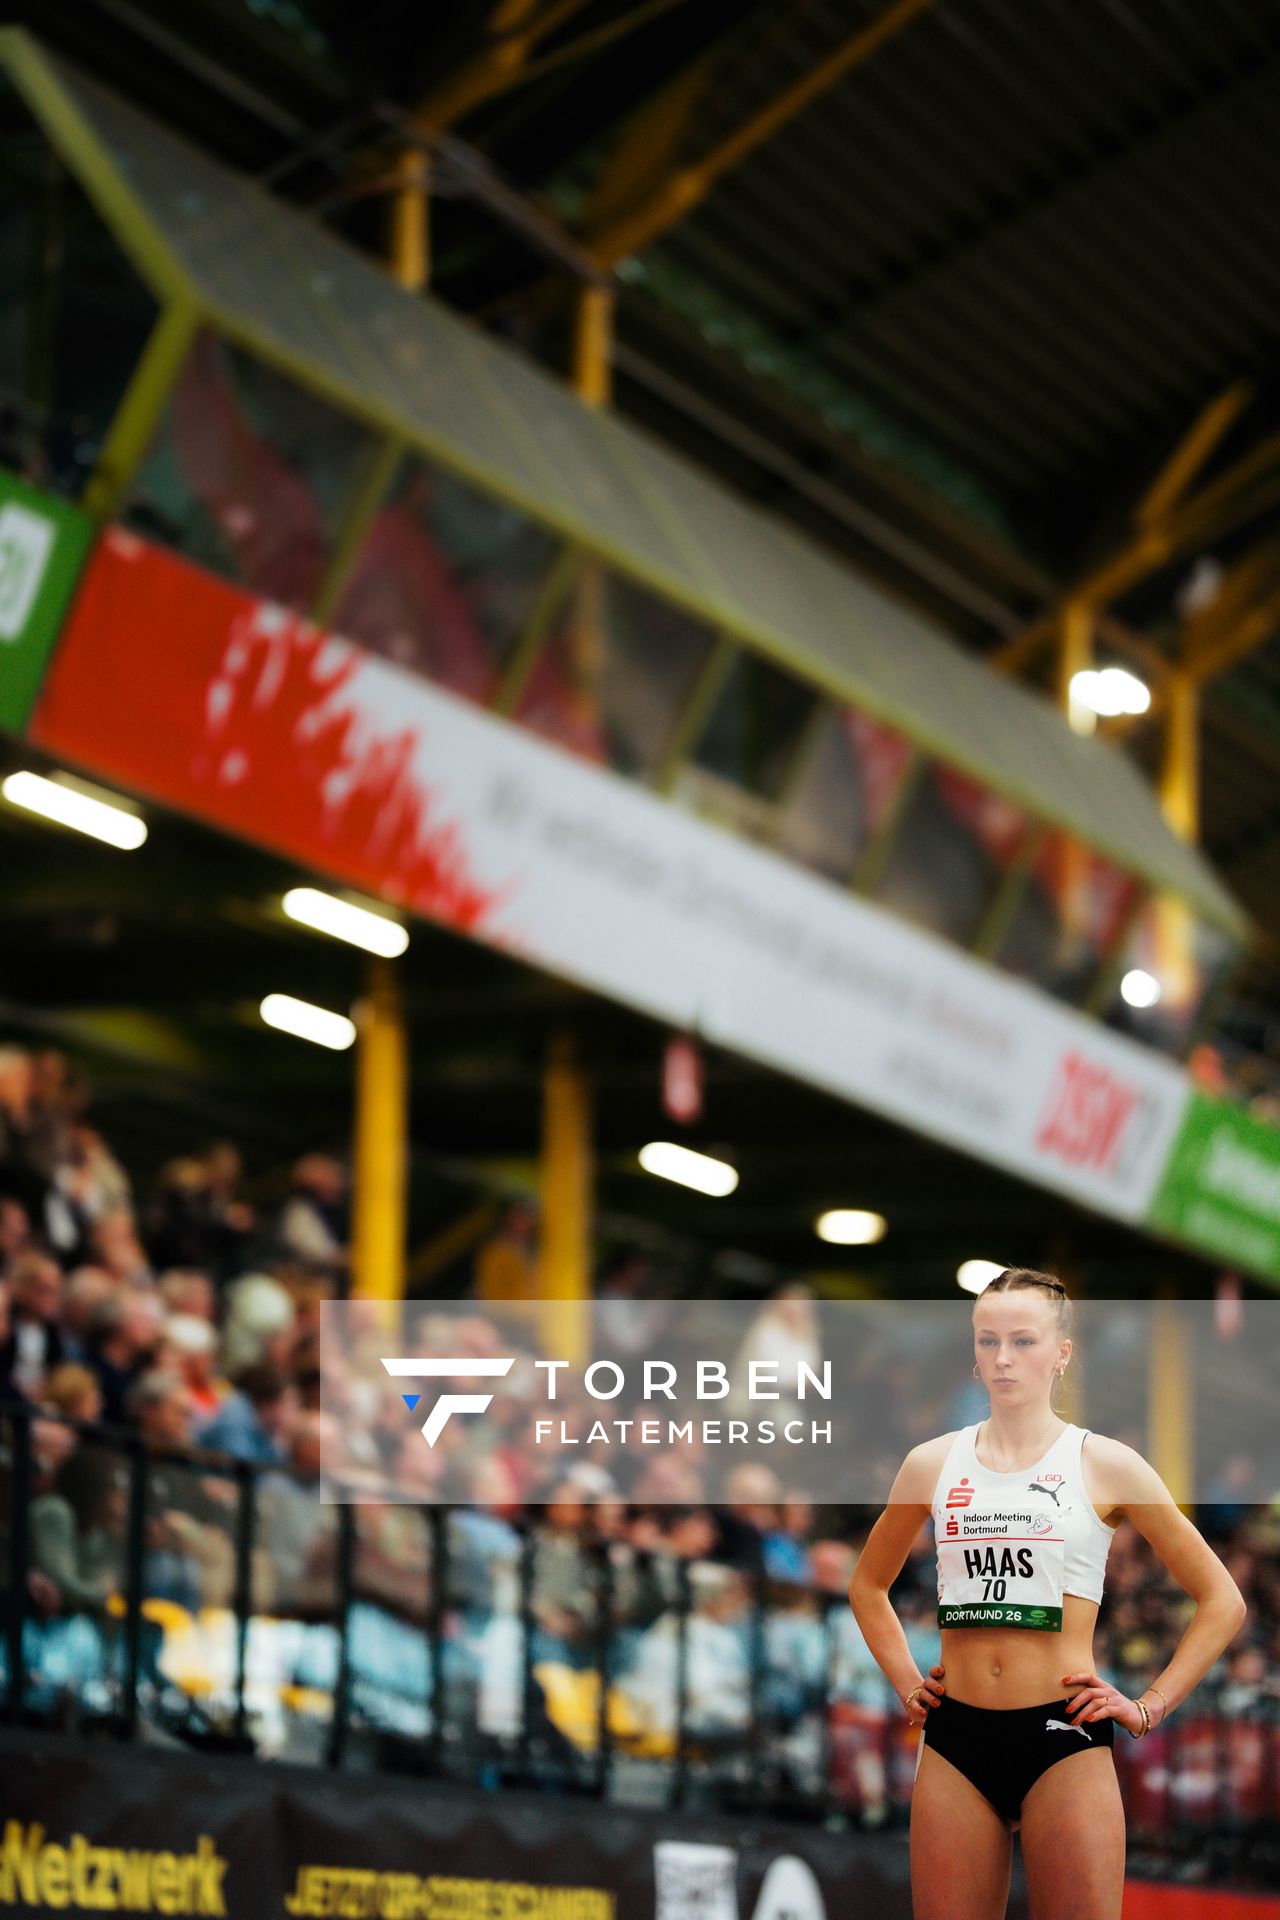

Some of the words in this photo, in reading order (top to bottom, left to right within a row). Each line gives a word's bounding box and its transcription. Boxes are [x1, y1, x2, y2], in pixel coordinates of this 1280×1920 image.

[963, 1513, 991, 1523] Indoor
[993, 1512, 1032, 1523] Meeting
[963, 1525, 1008, 1535] Dortmund
[963, 1547, 1034, 1579] HAAS
[981, 1579, 1007, 1602] 70
[946, 1609, 1003, 1622] DORTMUND
[1005, 1610, 1022, 1622] 26
[0, 1821, 228, 1917] Netzwerk
